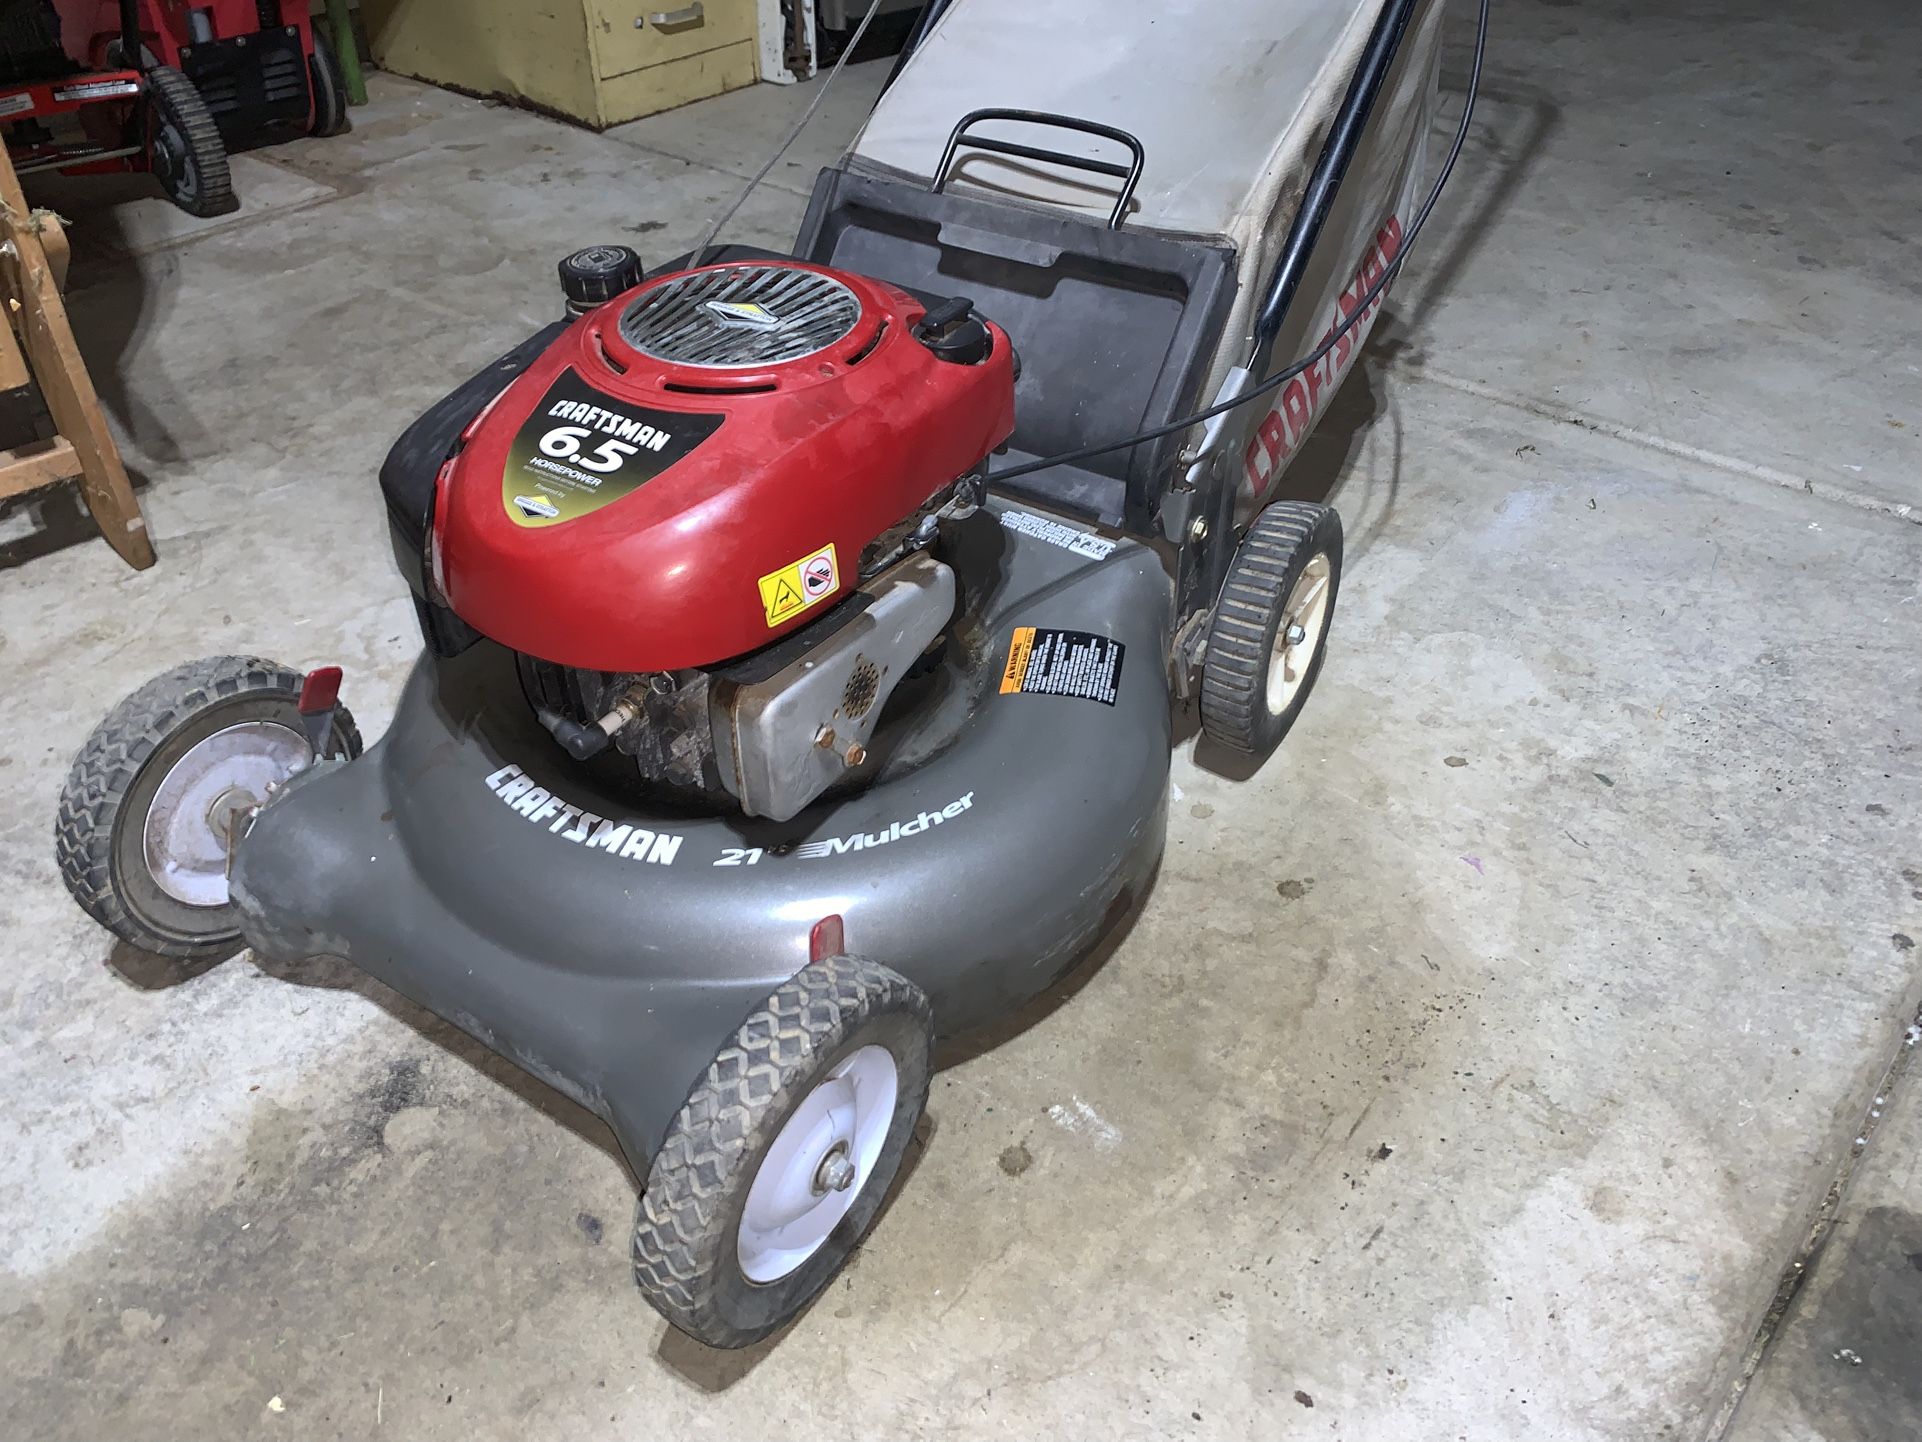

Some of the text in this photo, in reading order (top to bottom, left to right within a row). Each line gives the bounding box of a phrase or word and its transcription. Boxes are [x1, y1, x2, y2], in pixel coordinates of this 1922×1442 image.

[1244, 214, 1402, 499] CRAFTSMAN
[538, 426, 639, 474] 6.5
[548, 400, 671, 452] CRAFTSMAN
[529, 456, 603, 487] HORSEPOWER
[485, 763, 684, 866] CRAFTSMAN
[712, 791, 975, 867] 21 Mulcher
